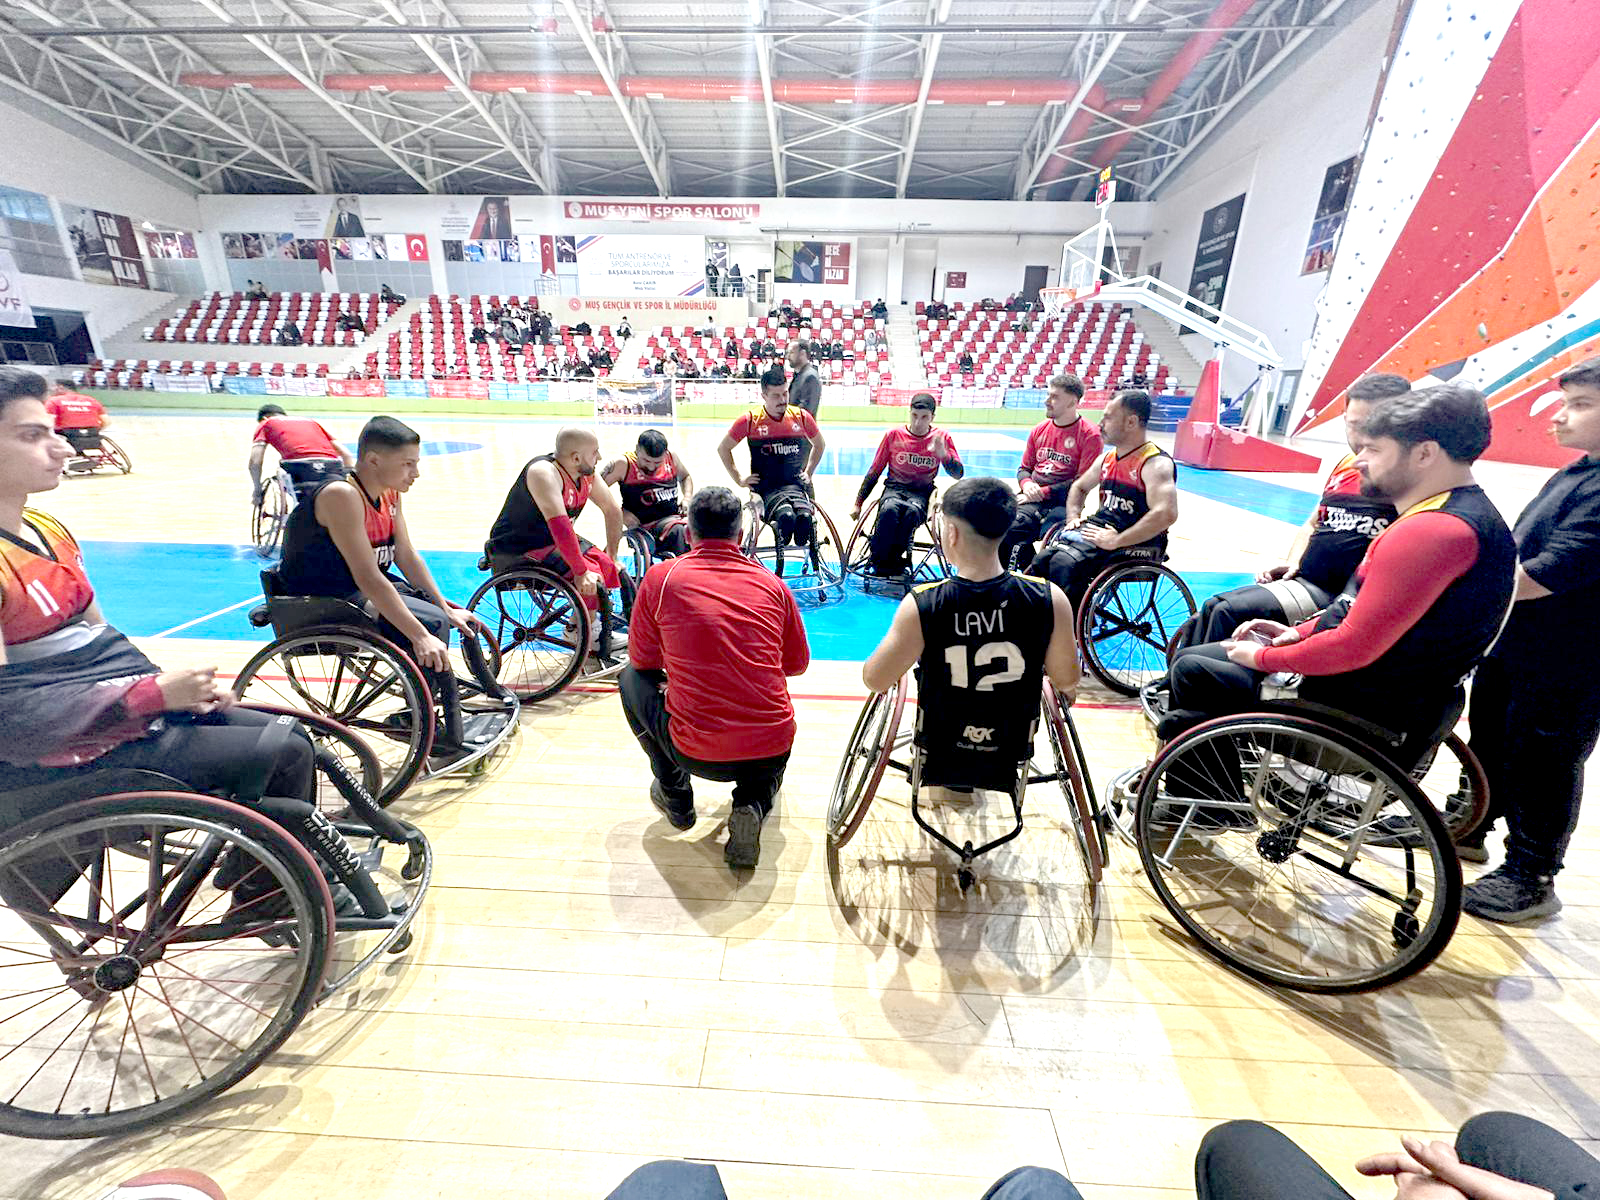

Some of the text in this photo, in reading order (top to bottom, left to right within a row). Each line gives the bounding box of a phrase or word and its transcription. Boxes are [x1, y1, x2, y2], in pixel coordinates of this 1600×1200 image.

[654, 206, 693, 218] SPOR
[696, 206, 753, 219] SALONU
[585, 299, 717, 312] MUŞ GENÇLİK VE SPOR İL MÜDÜRLÜĞÜ
[944, 641, 1026, 692] 12
